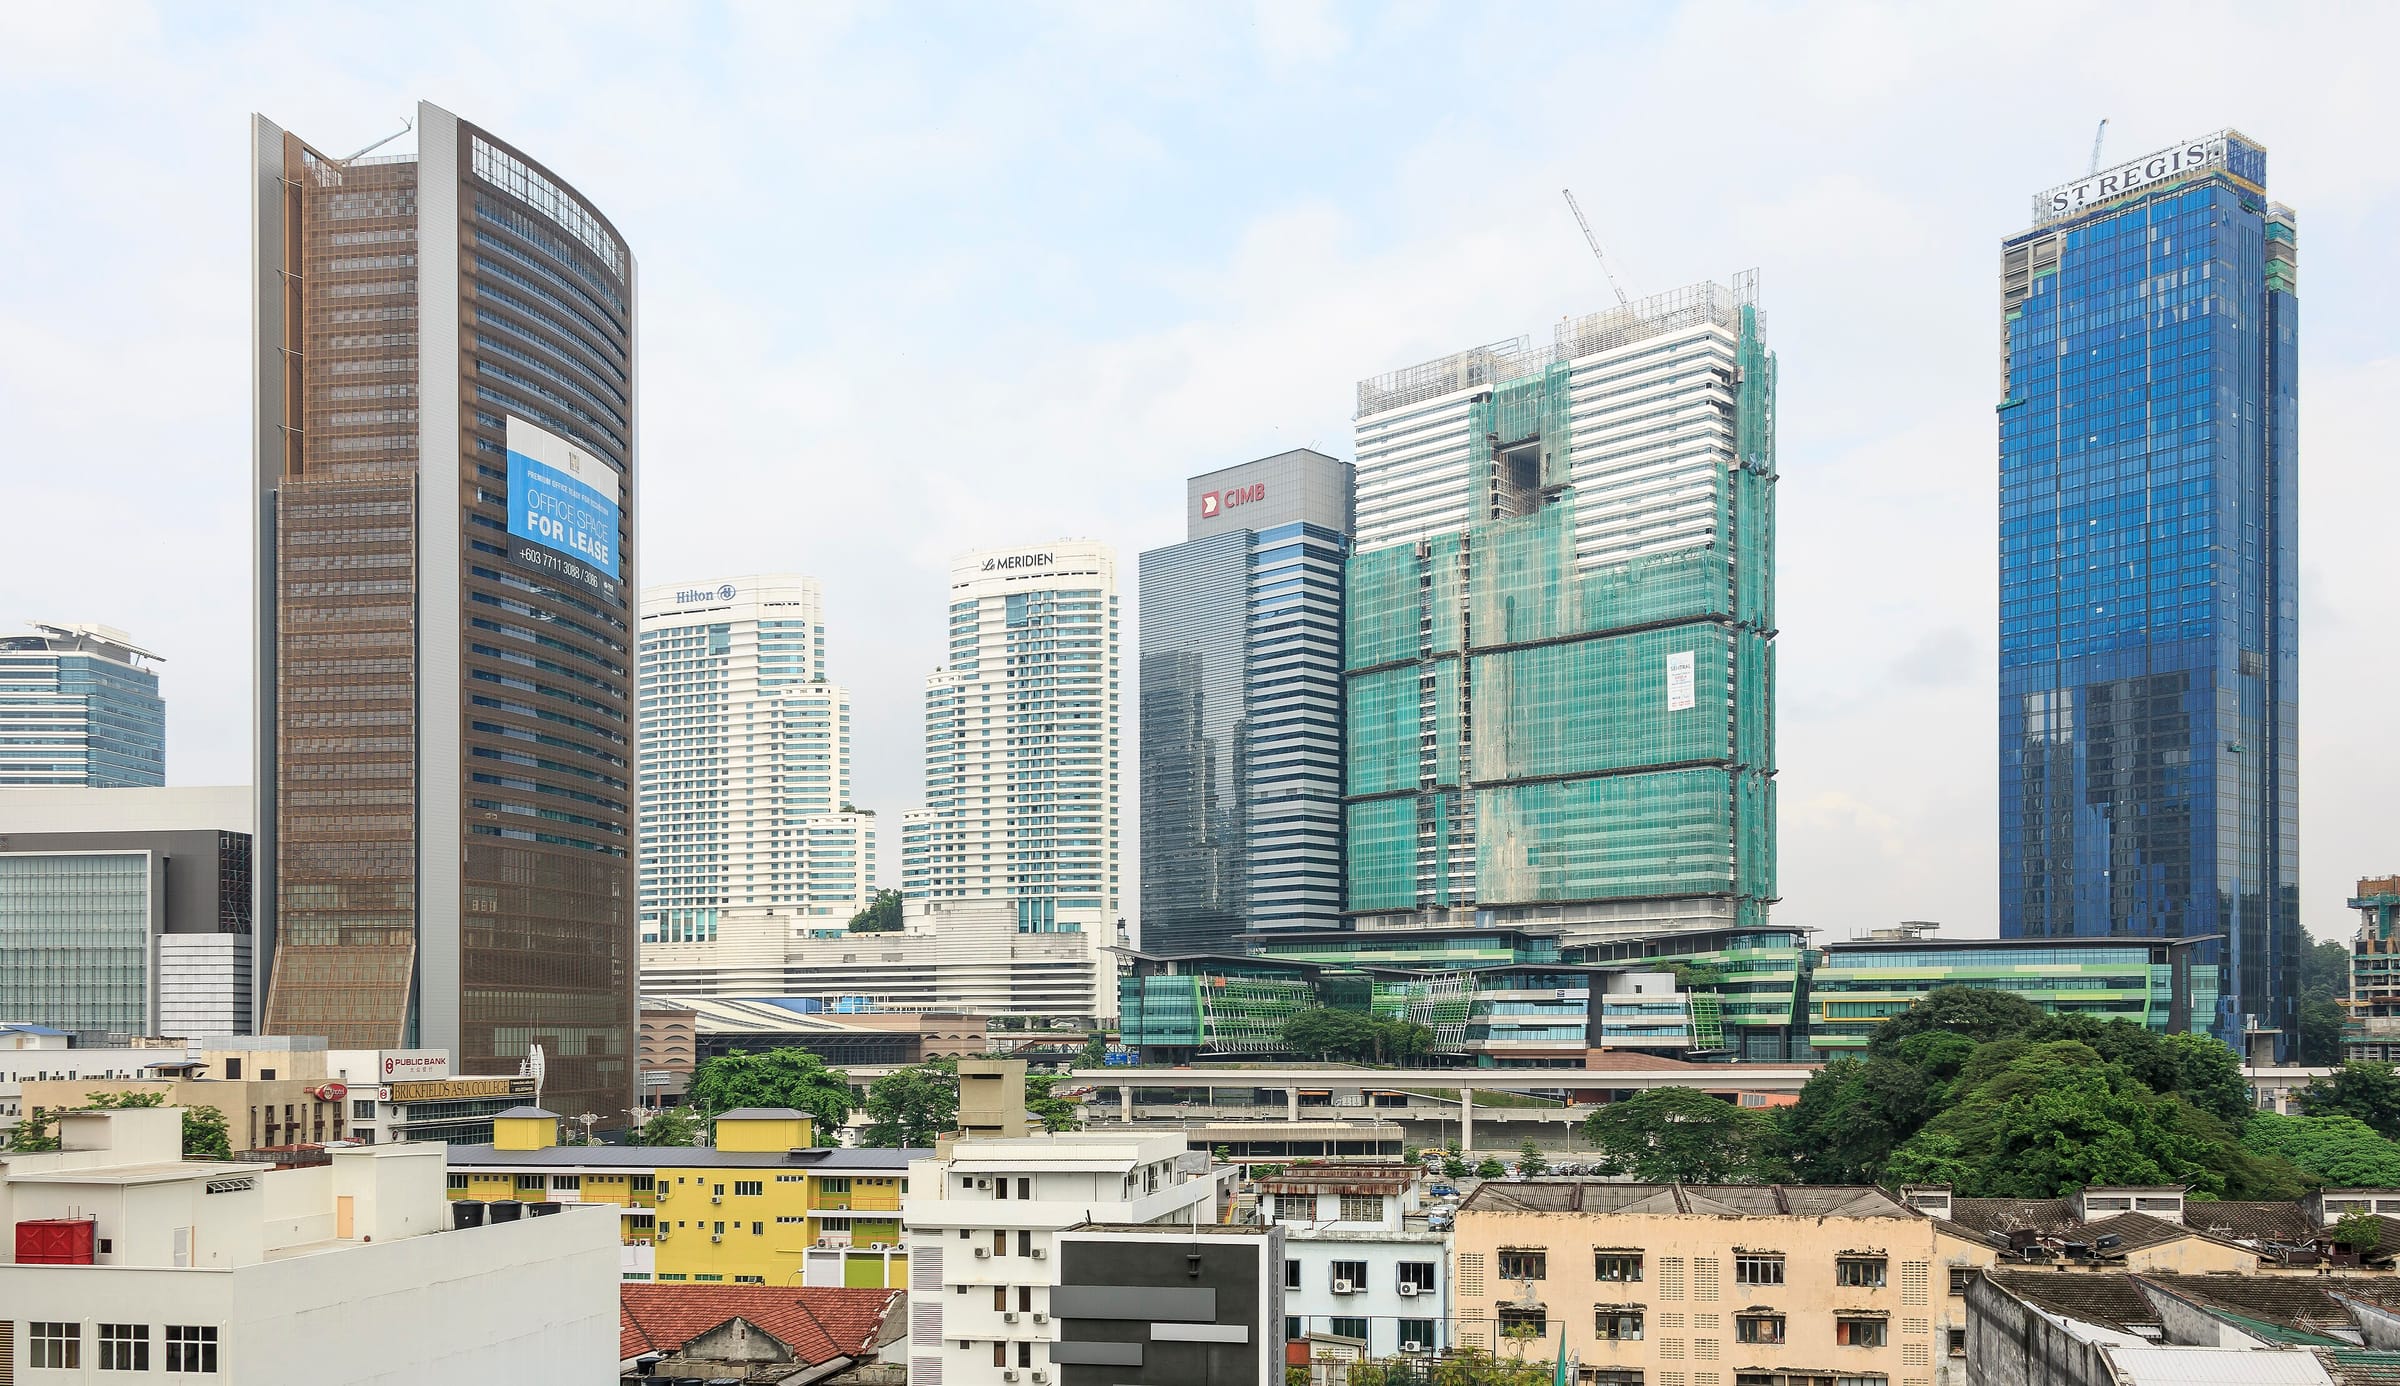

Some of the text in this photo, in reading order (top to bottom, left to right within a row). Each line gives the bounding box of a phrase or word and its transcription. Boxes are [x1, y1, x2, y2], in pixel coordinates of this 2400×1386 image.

[2099, 143, 2206, 198] REGIS
[551, 479, 569, 494] OFFICE
[1223, 483, 1265, 508] CIMB
[527, 489, 576, 523] OFFICE
[577, 509, 609, 543] SPACE
[527, 511, 609, 566] FOR LEASE
[519, 547, 541, 565] +603
[543, 553, 562, 571] 7711
[981, 552, 1053, 571] Le MERIDIEN
[676, 589, 714, 603] Hilton
[395, 1057, 446, 1066] PUBLIC BANK
[394, 1080, 509, 1100] BRICKFIELDS ASIA COLLEGE
